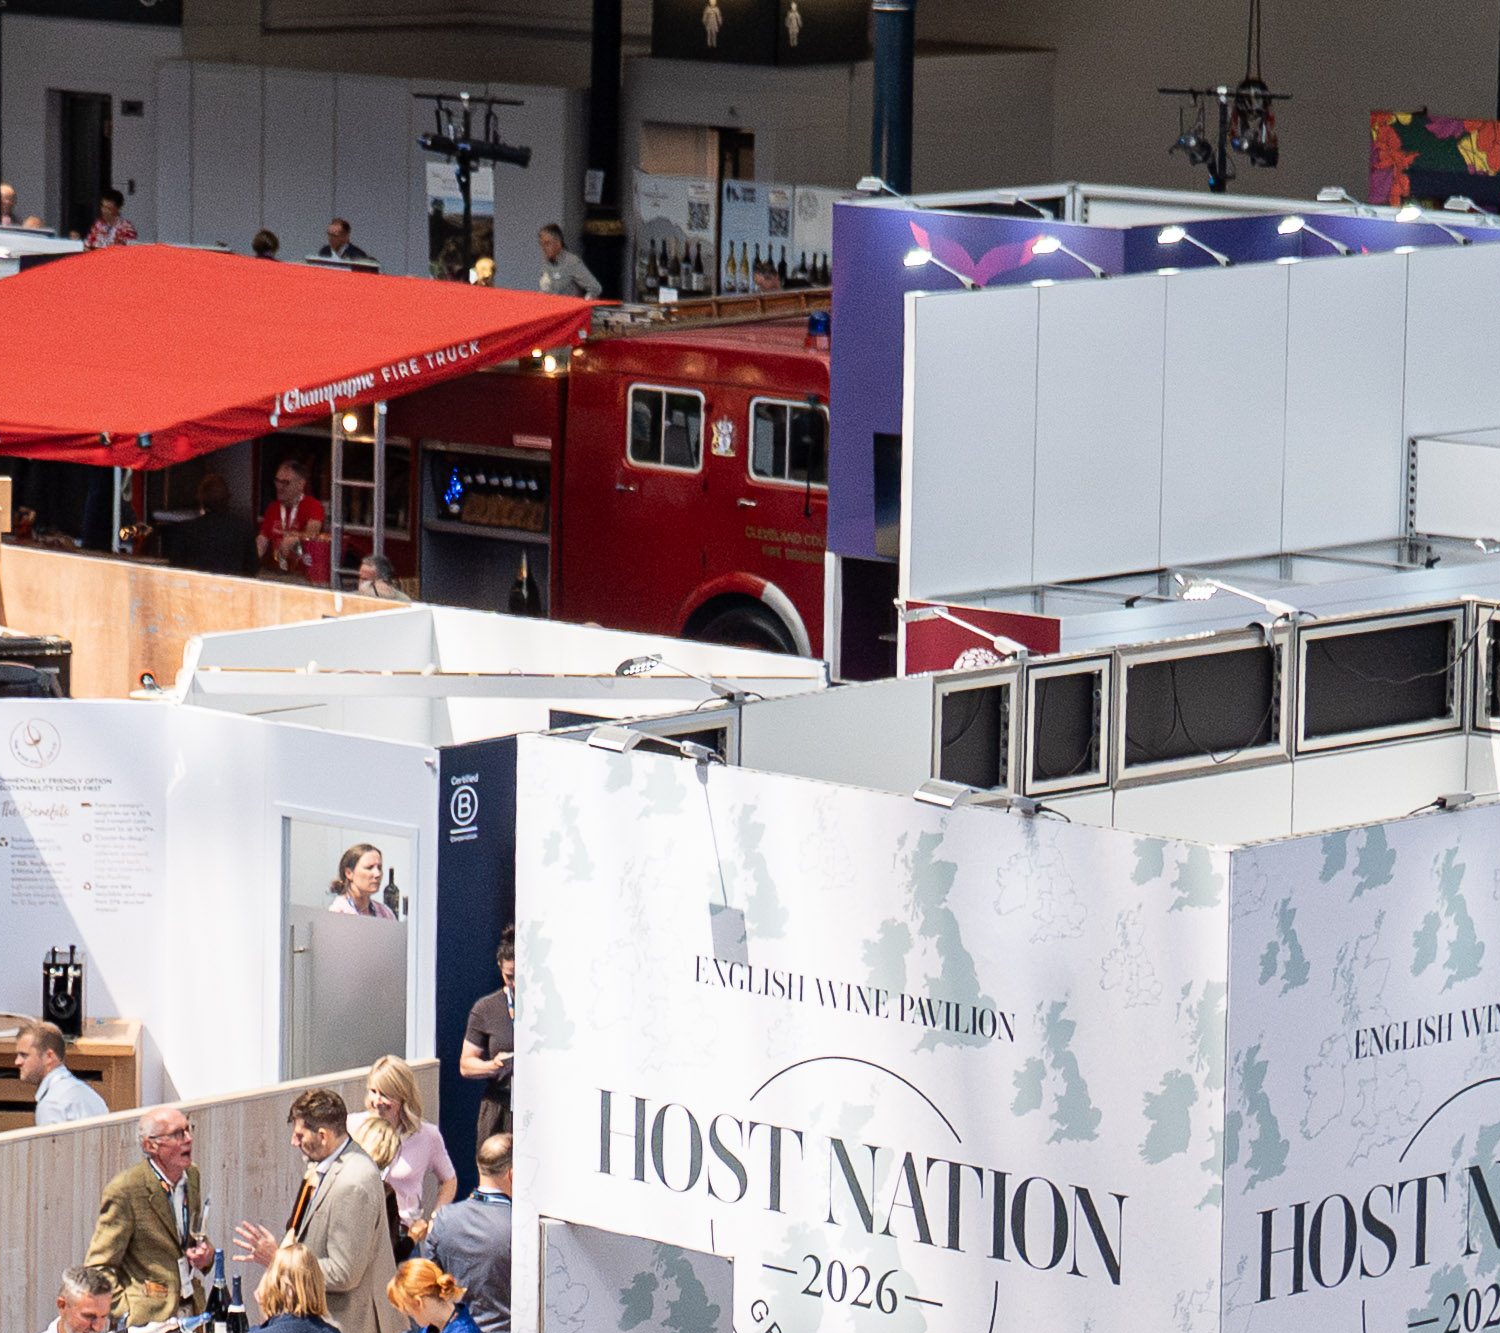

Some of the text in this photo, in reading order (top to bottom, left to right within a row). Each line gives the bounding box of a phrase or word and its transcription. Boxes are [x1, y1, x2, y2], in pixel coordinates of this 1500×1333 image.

[282, 340, 481, 413] Champagne FIRE TRUCK
[694, 953, 1017, 1044] ENGLISH WINE PAVILION
[1353, 1013, 1455, 1060] ENGLISH
[595, 1087, 1130, 1287] HOST NATION
[1254, 1174, 1451, 1304] HOST
[799, 1252, 899, 1315] 2026
